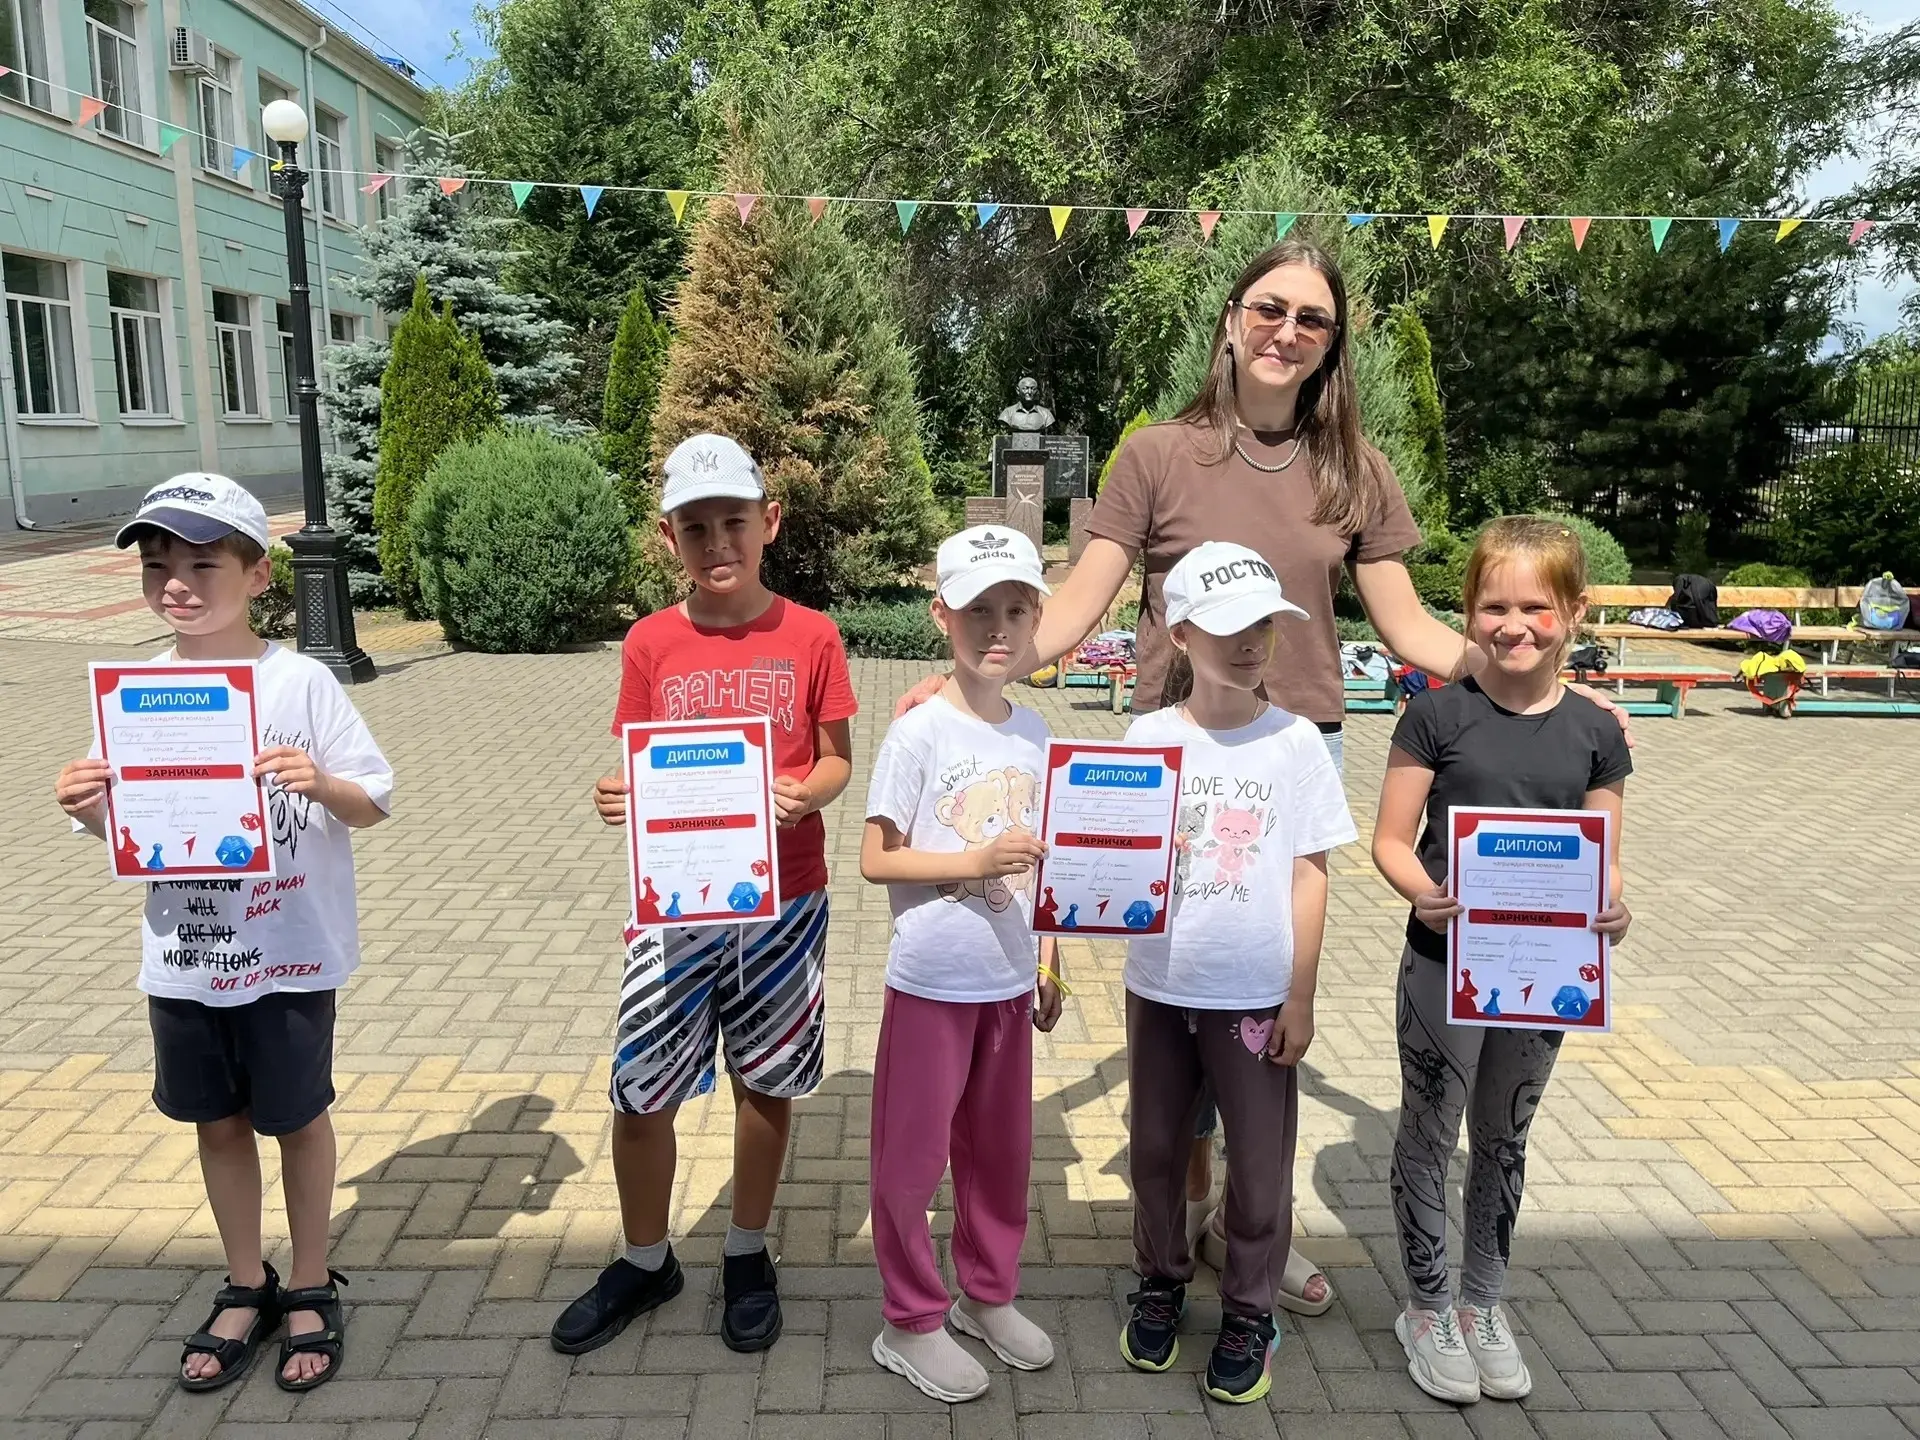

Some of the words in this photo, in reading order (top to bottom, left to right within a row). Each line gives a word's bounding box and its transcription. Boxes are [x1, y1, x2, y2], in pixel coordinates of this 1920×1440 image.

[691, 450, 719, 473] NY
[970, 550, 1016, 563] adidas
[752, 656, 796, 672] ZONE
[139, 692, 210, 709] ДИПЛОМ
[661, 669, 796, 732] GAMER
[263, 723, 312, 754] tivity
[666, 748, 729, 765] ДИПЛОМ
[145, 767, 210, 778] ЗАРНИЧКА
[1084, 769, 1148, 783] ДИПЛОМ
[1182, 776, 1224, 796] LOVE
[1234, 777, 1273, 802] YOU
[668, 818, 726, 830] ЗАРНИЧКА
[1076, 836, 1133, 847] ЗАРНИЧКА
[1494, 838, 1562, 853] ДИПЛОМ
[251, 880, 271, 903] NO
[275, 873, 306, 892] WAY
[1230, 883, 1251, 903] ME
[186, 897, 218, 917] WILL
[245, 898, 282, 922] BACK
[1491, 913, 1553, 924] ЗАРНИЧКА
[177, 923, 206, 943] GIVE
[210, 923, 237, 944] YOU
[163, 949, 199, 967] MORE
[202, 947, 263, 972] OPTIONS
[210, 976, 240, 991] OUT
[244, 971, 260, 988] OF
[262, 962, 322, 981] SYSTEM
